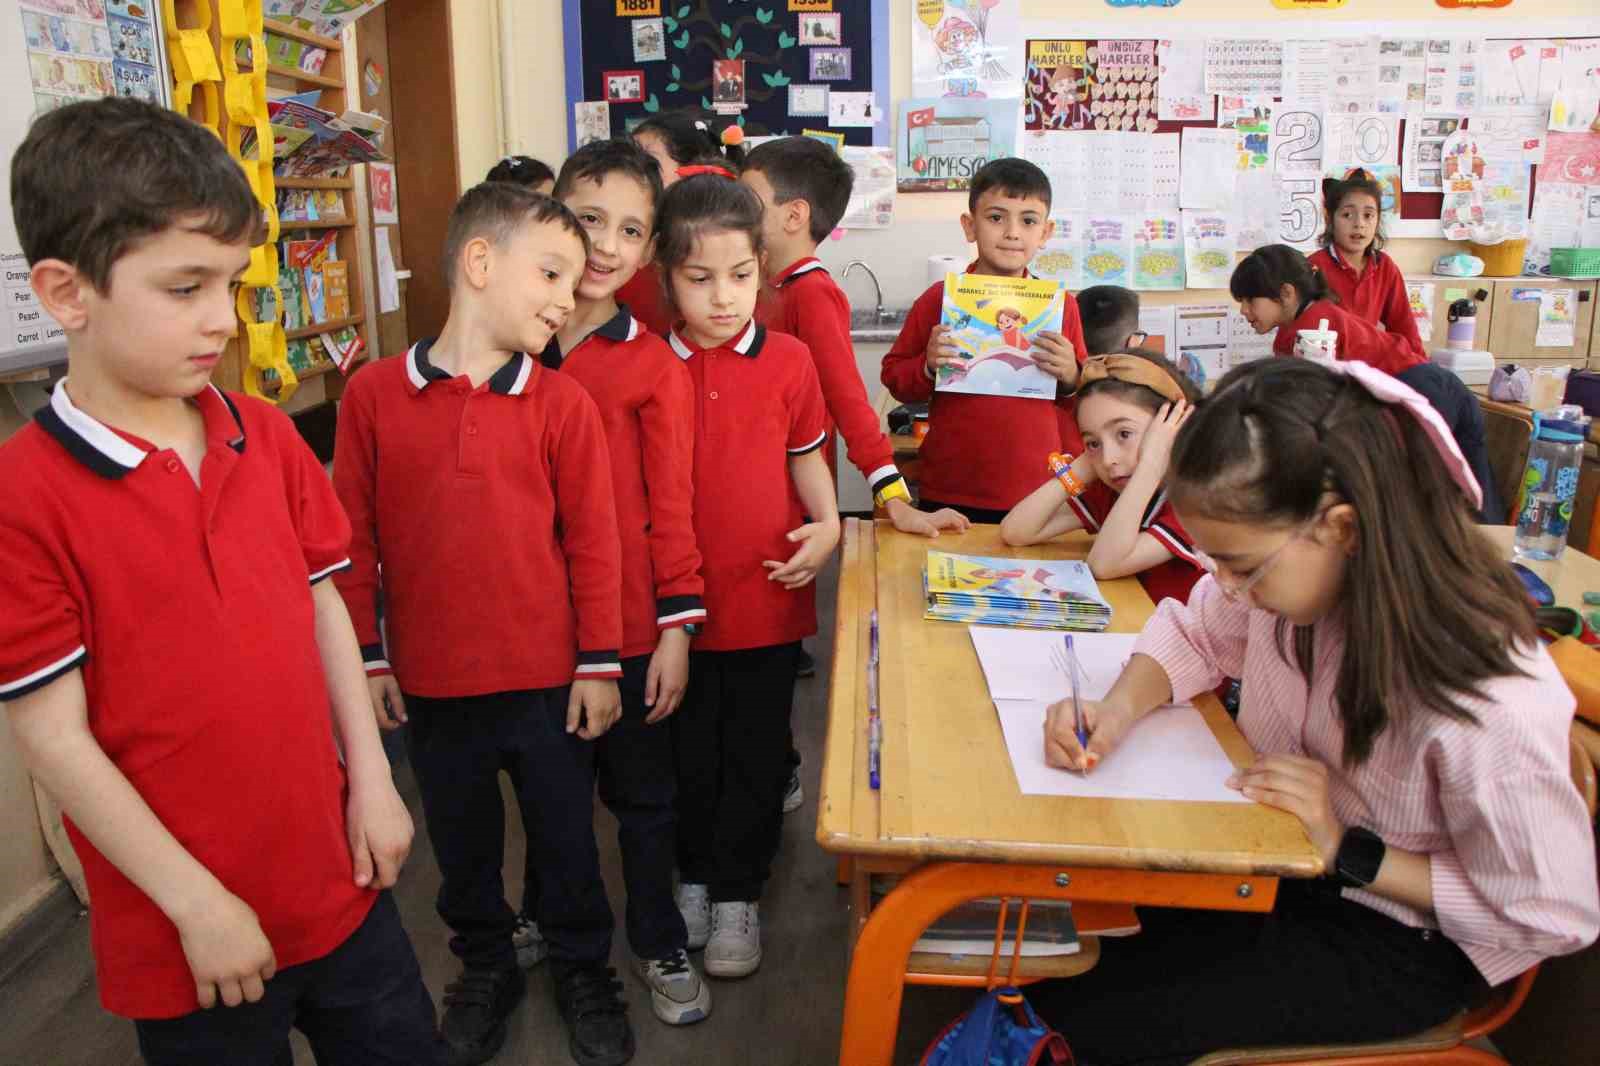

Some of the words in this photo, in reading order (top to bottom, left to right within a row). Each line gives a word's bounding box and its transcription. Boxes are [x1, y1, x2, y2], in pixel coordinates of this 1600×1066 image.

[1031, 54, 1083, 65] HARFLER
[1099, 54, 1151, 65] HARFLER
[17, 332, 40, 343] Carrot
[46, 327, 64, 338] Lemo
